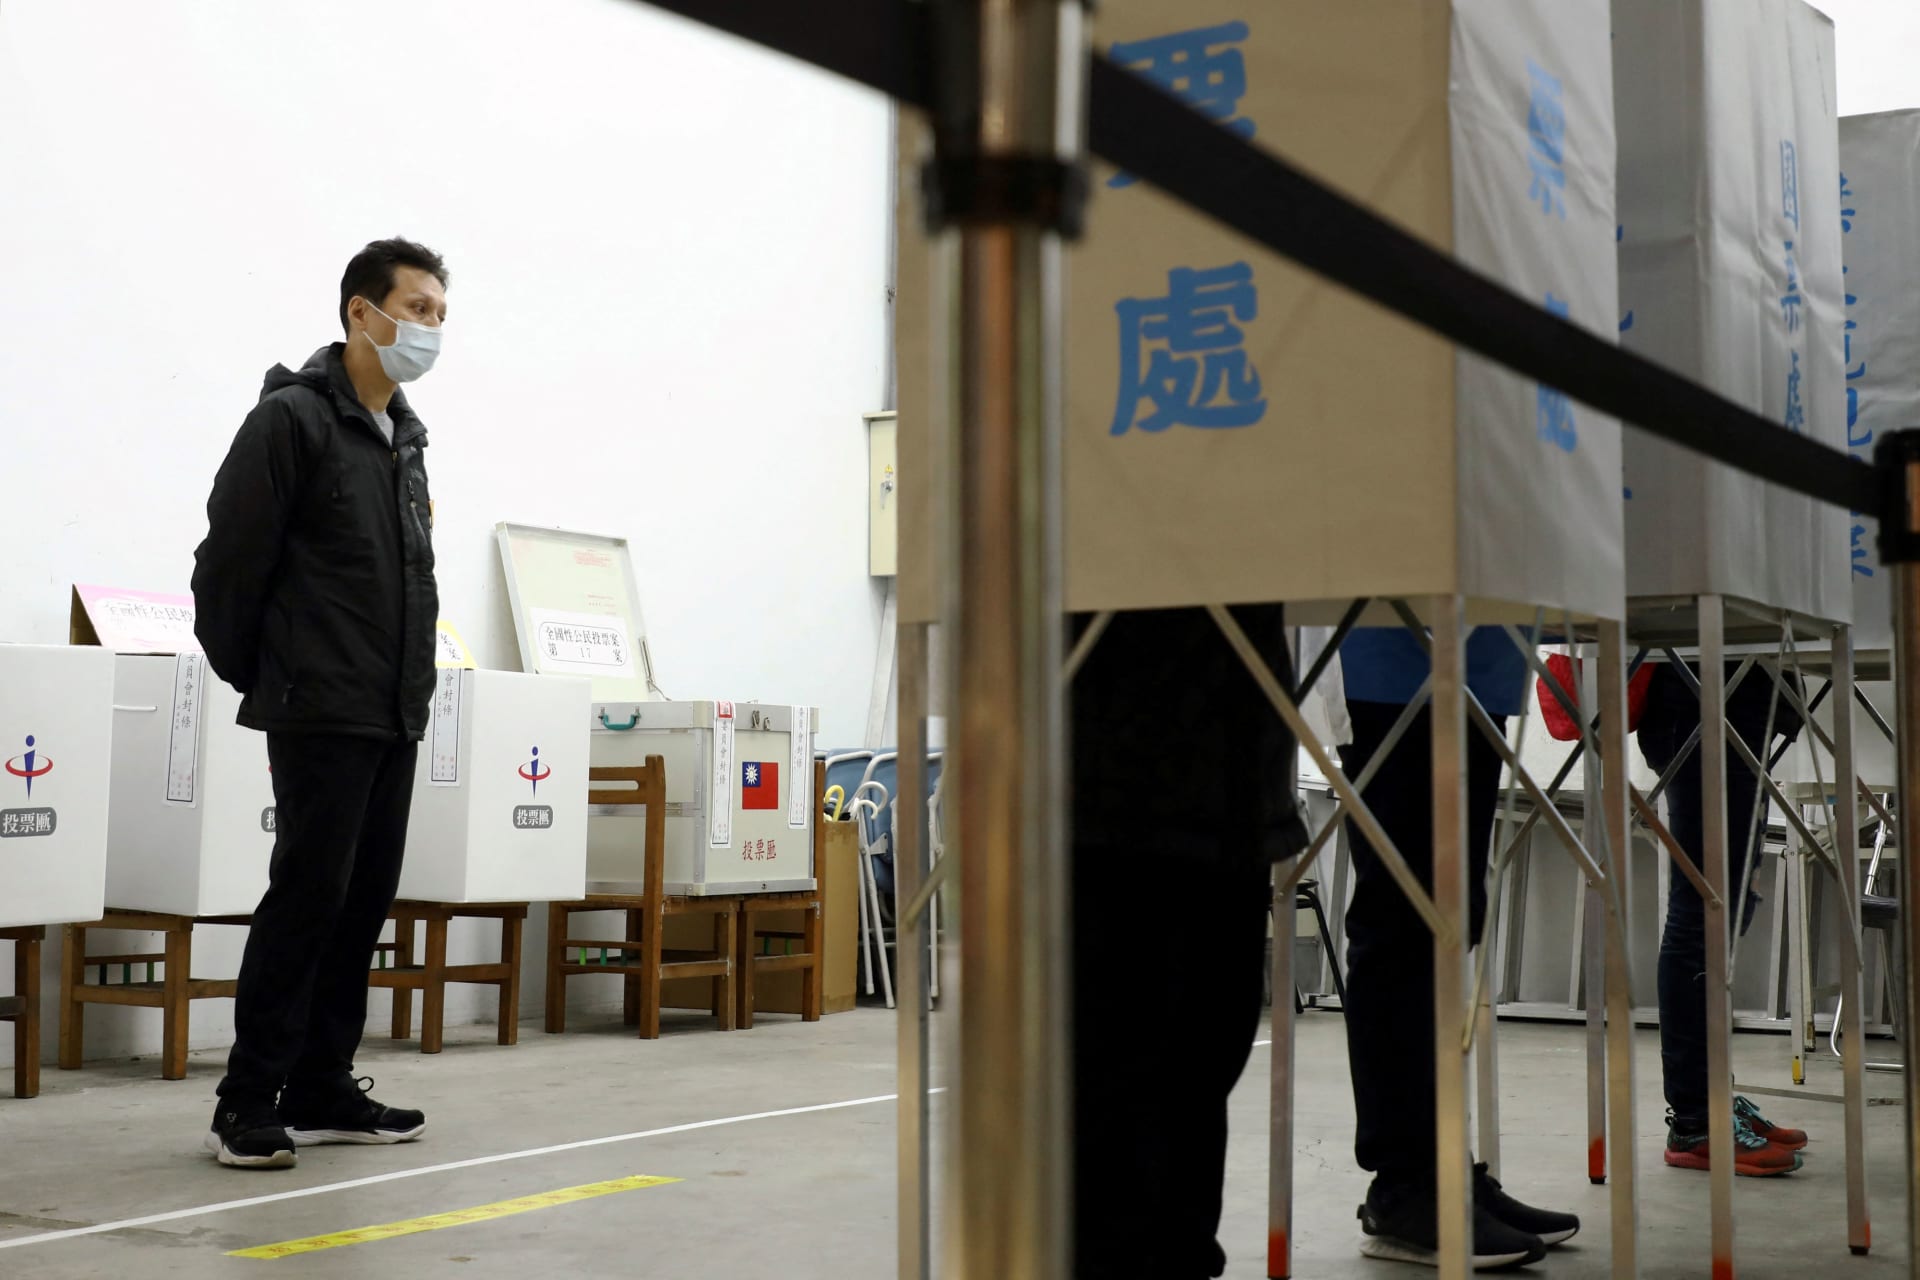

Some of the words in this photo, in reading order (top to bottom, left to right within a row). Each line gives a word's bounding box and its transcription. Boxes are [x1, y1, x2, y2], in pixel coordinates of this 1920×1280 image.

[545, 626, 620, 648] 全國性公民投票案
[580, 646, 591, 659] 17
[612, 648, 623, 664] 案
